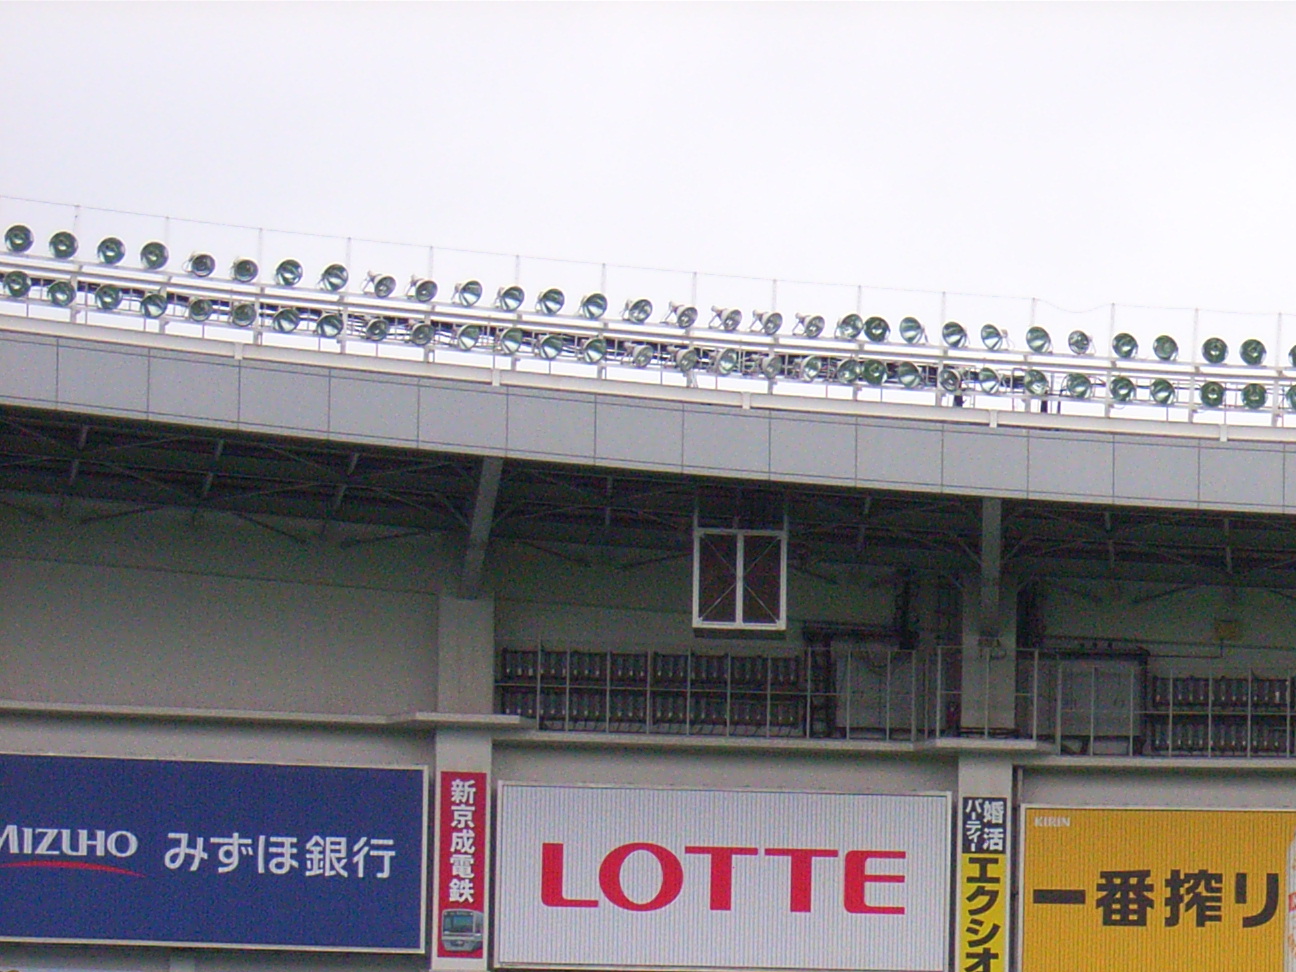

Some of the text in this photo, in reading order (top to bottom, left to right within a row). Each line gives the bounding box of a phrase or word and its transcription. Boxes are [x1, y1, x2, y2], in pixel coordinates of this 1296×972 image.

[449, 779, 477, 904] 新京成電鉄
[965, 799, 982, 852] パーティー
[983, 800, 1004, 851] 婚活
[1034, 817, 1071, 827] KIRIN
[164, 831, 396, 879] みずほ銀行
[541, 842, 906, 915] LOTTE
[1033, 868, 1280, 930] 一番搾り
